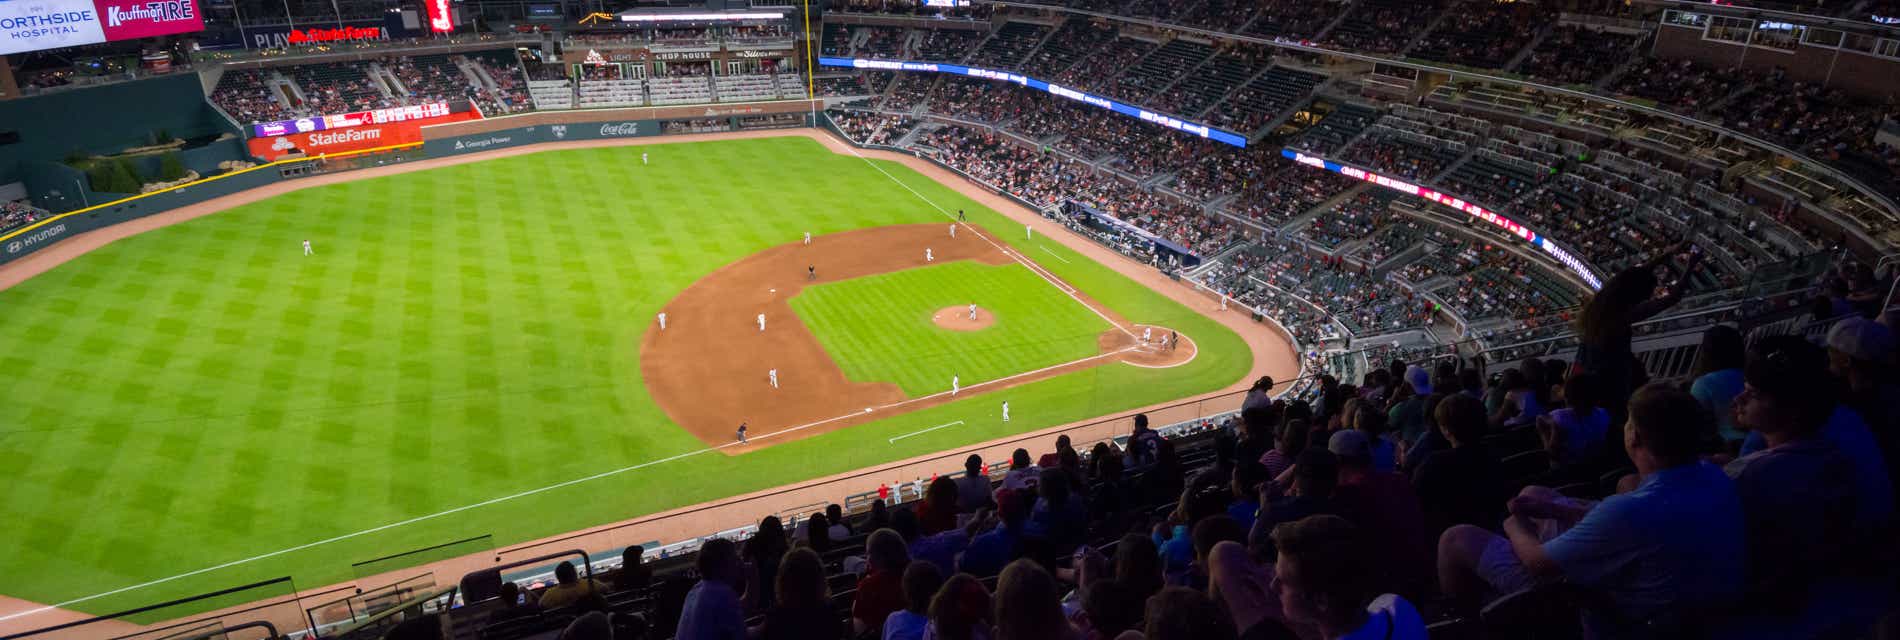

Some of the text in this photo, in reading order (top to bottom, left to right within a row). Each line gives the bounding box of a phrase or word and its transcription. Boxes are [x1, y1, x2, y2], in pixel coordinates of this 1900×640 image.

[107, 0, 194, 27] Kauffman TIRE
[11, 26, 79, 39] HOSPITAL
[254, 31, 290, 49] PLAY
[465, 136, 511, 149] Georgia Power
[24, 224, 66, 246] HYUNDAI
